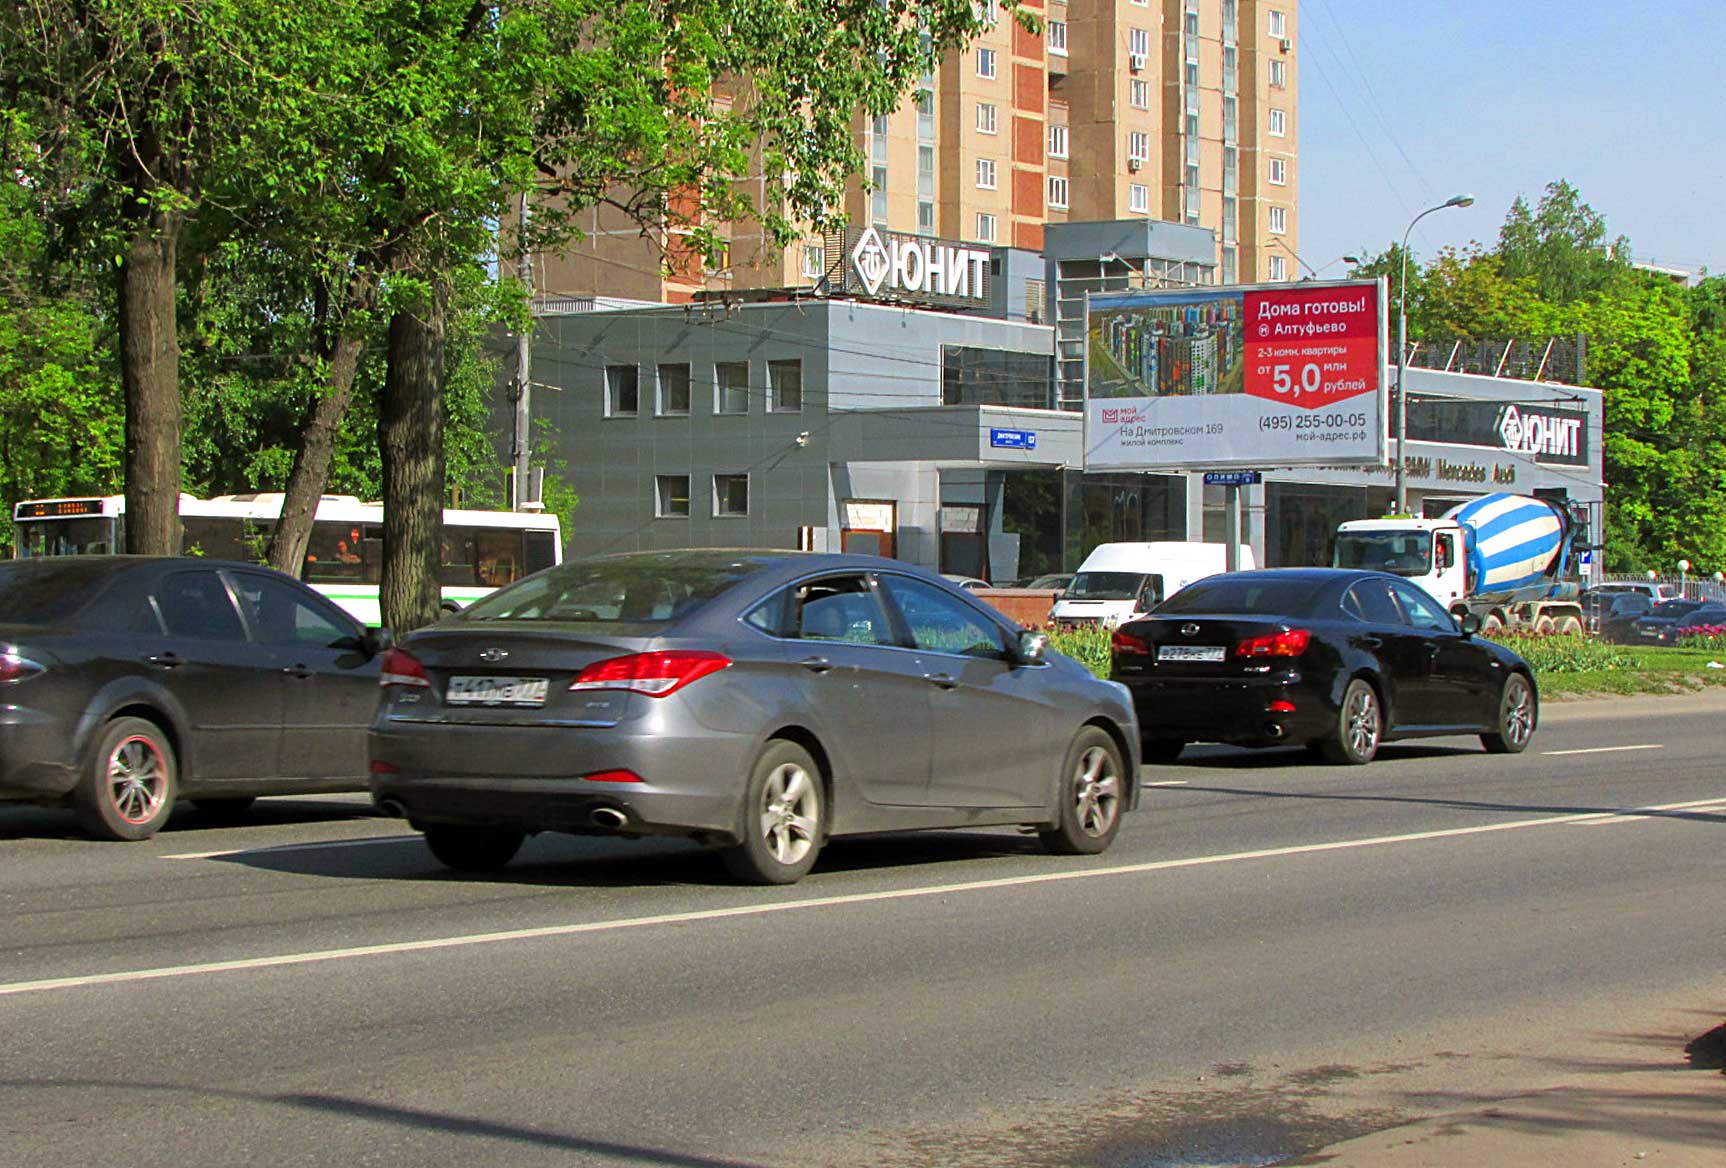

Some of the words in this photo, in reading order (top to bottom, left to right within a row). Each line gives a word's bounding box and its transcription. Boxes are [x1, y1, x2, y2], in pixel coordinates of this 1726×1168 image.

[889, 239, 991, 299] ЮНИТ
[1258, 301, 1300, 320] Дома
[1304, 297, 1366, 316] готовы!
[1275, 322, 1346, 336] Алтуфьево
[1258, 348, 1272, 358] 2-3
[1274, 348, 1299, 357] комн.
[1302, 346, 1347, 357] квартиры
[1258, 367, 1271, 375] от
[1273, 364, 1321, 397] 5,0
[1324, 362, 1347, 372] млн
[1324, 380, 1366, 393] рублей
[1120, 406, 1137, 415] мой
[1120, 415, 1146, 423] адрес
[1259, 416, 1292, 431] (495)
[1296, 414, 1366, 428] 255-00-05
[1120, 427, 1134, 437] На
[1136, 426, 1204, 438] Дмитровском
[1206, 424, 1223, 434] 169
[1296, 430, 1366, 442] мой-адрес.рф
[1521, 414, 1583, 457] ЮНИТ
[1147, 438, 1183, 446] комплекс
[1405, 456, 1431, 479] BMW
[1436, 458, 1485, 482] Mercedes
[1492, 462, 1516, 484] Audi
